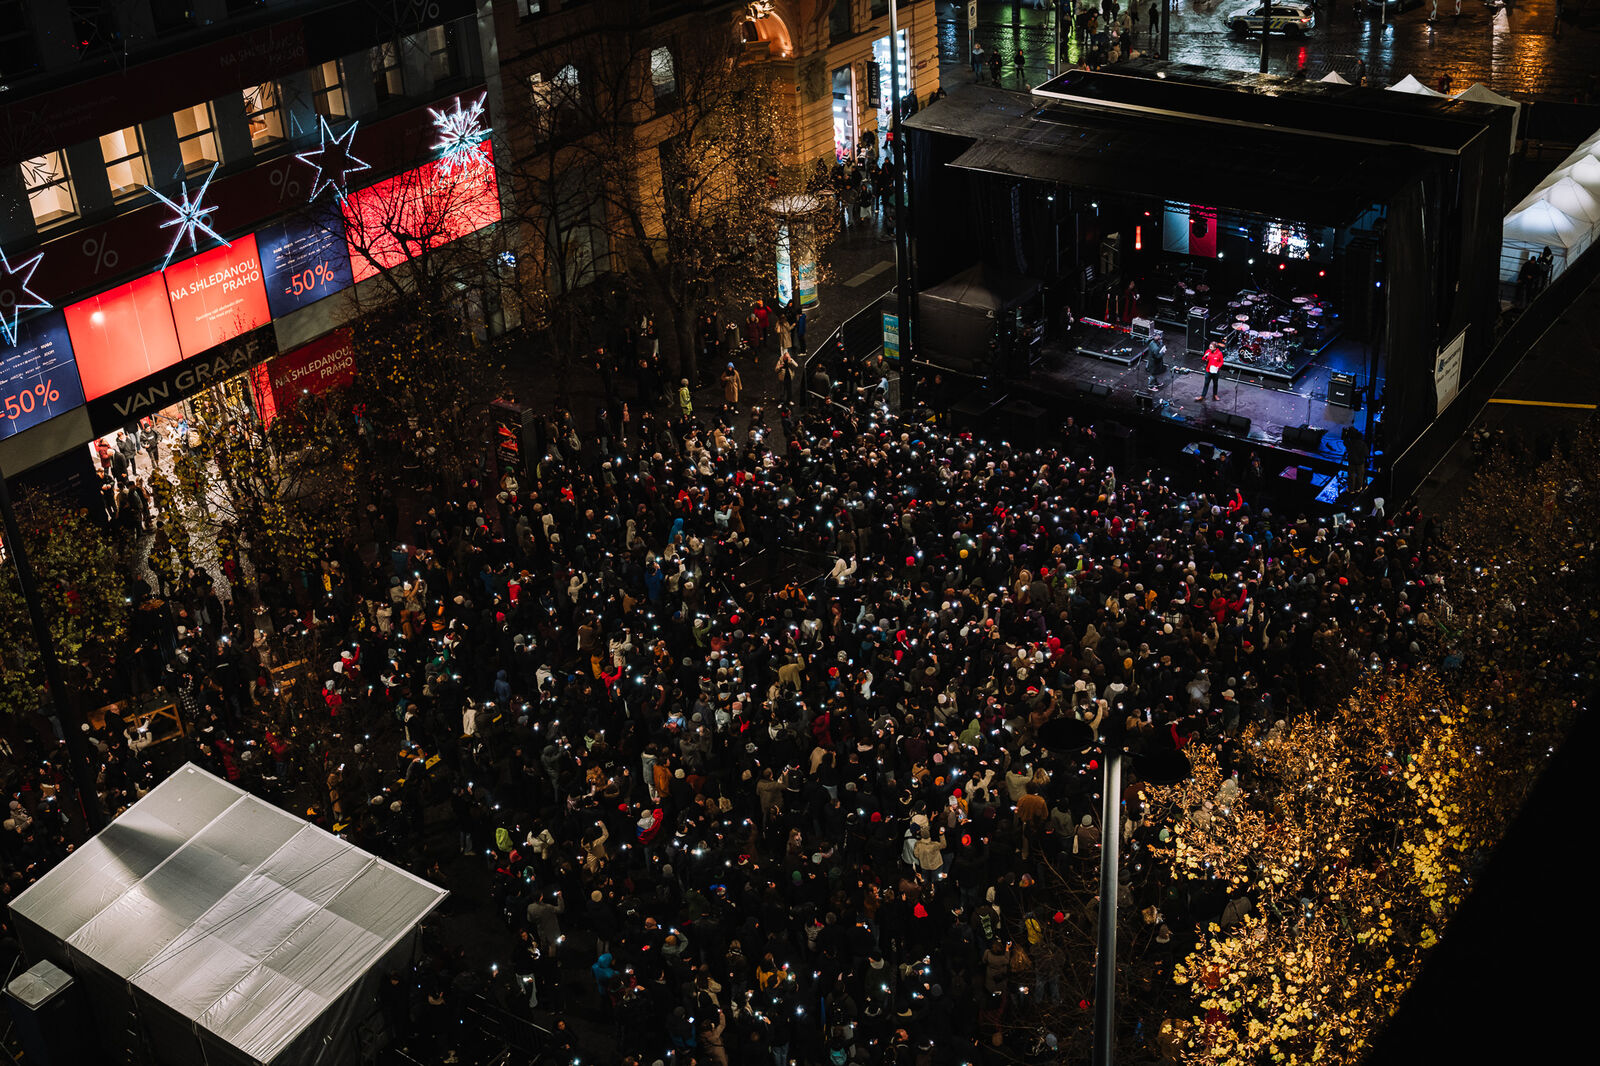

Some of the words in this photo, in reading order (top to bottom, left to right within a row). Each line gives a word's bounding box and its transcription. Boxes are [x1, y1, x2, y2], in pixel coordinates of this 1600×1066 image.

[170, 288, 189, 302] NA
[189, 258, 259, 294] SHLEDANOU,
[222, 270, 260, 294] PRAHO
[285, 261, 334, 296] -50%
[112, 380, 170, 417] VAN
[174, 340, 260, 391] GRAAF
[274, 374, 291, 389] NA
[291, 345, 353, 381] SHLEDANOU,
[320, 356, 353, 380] PRAHO
